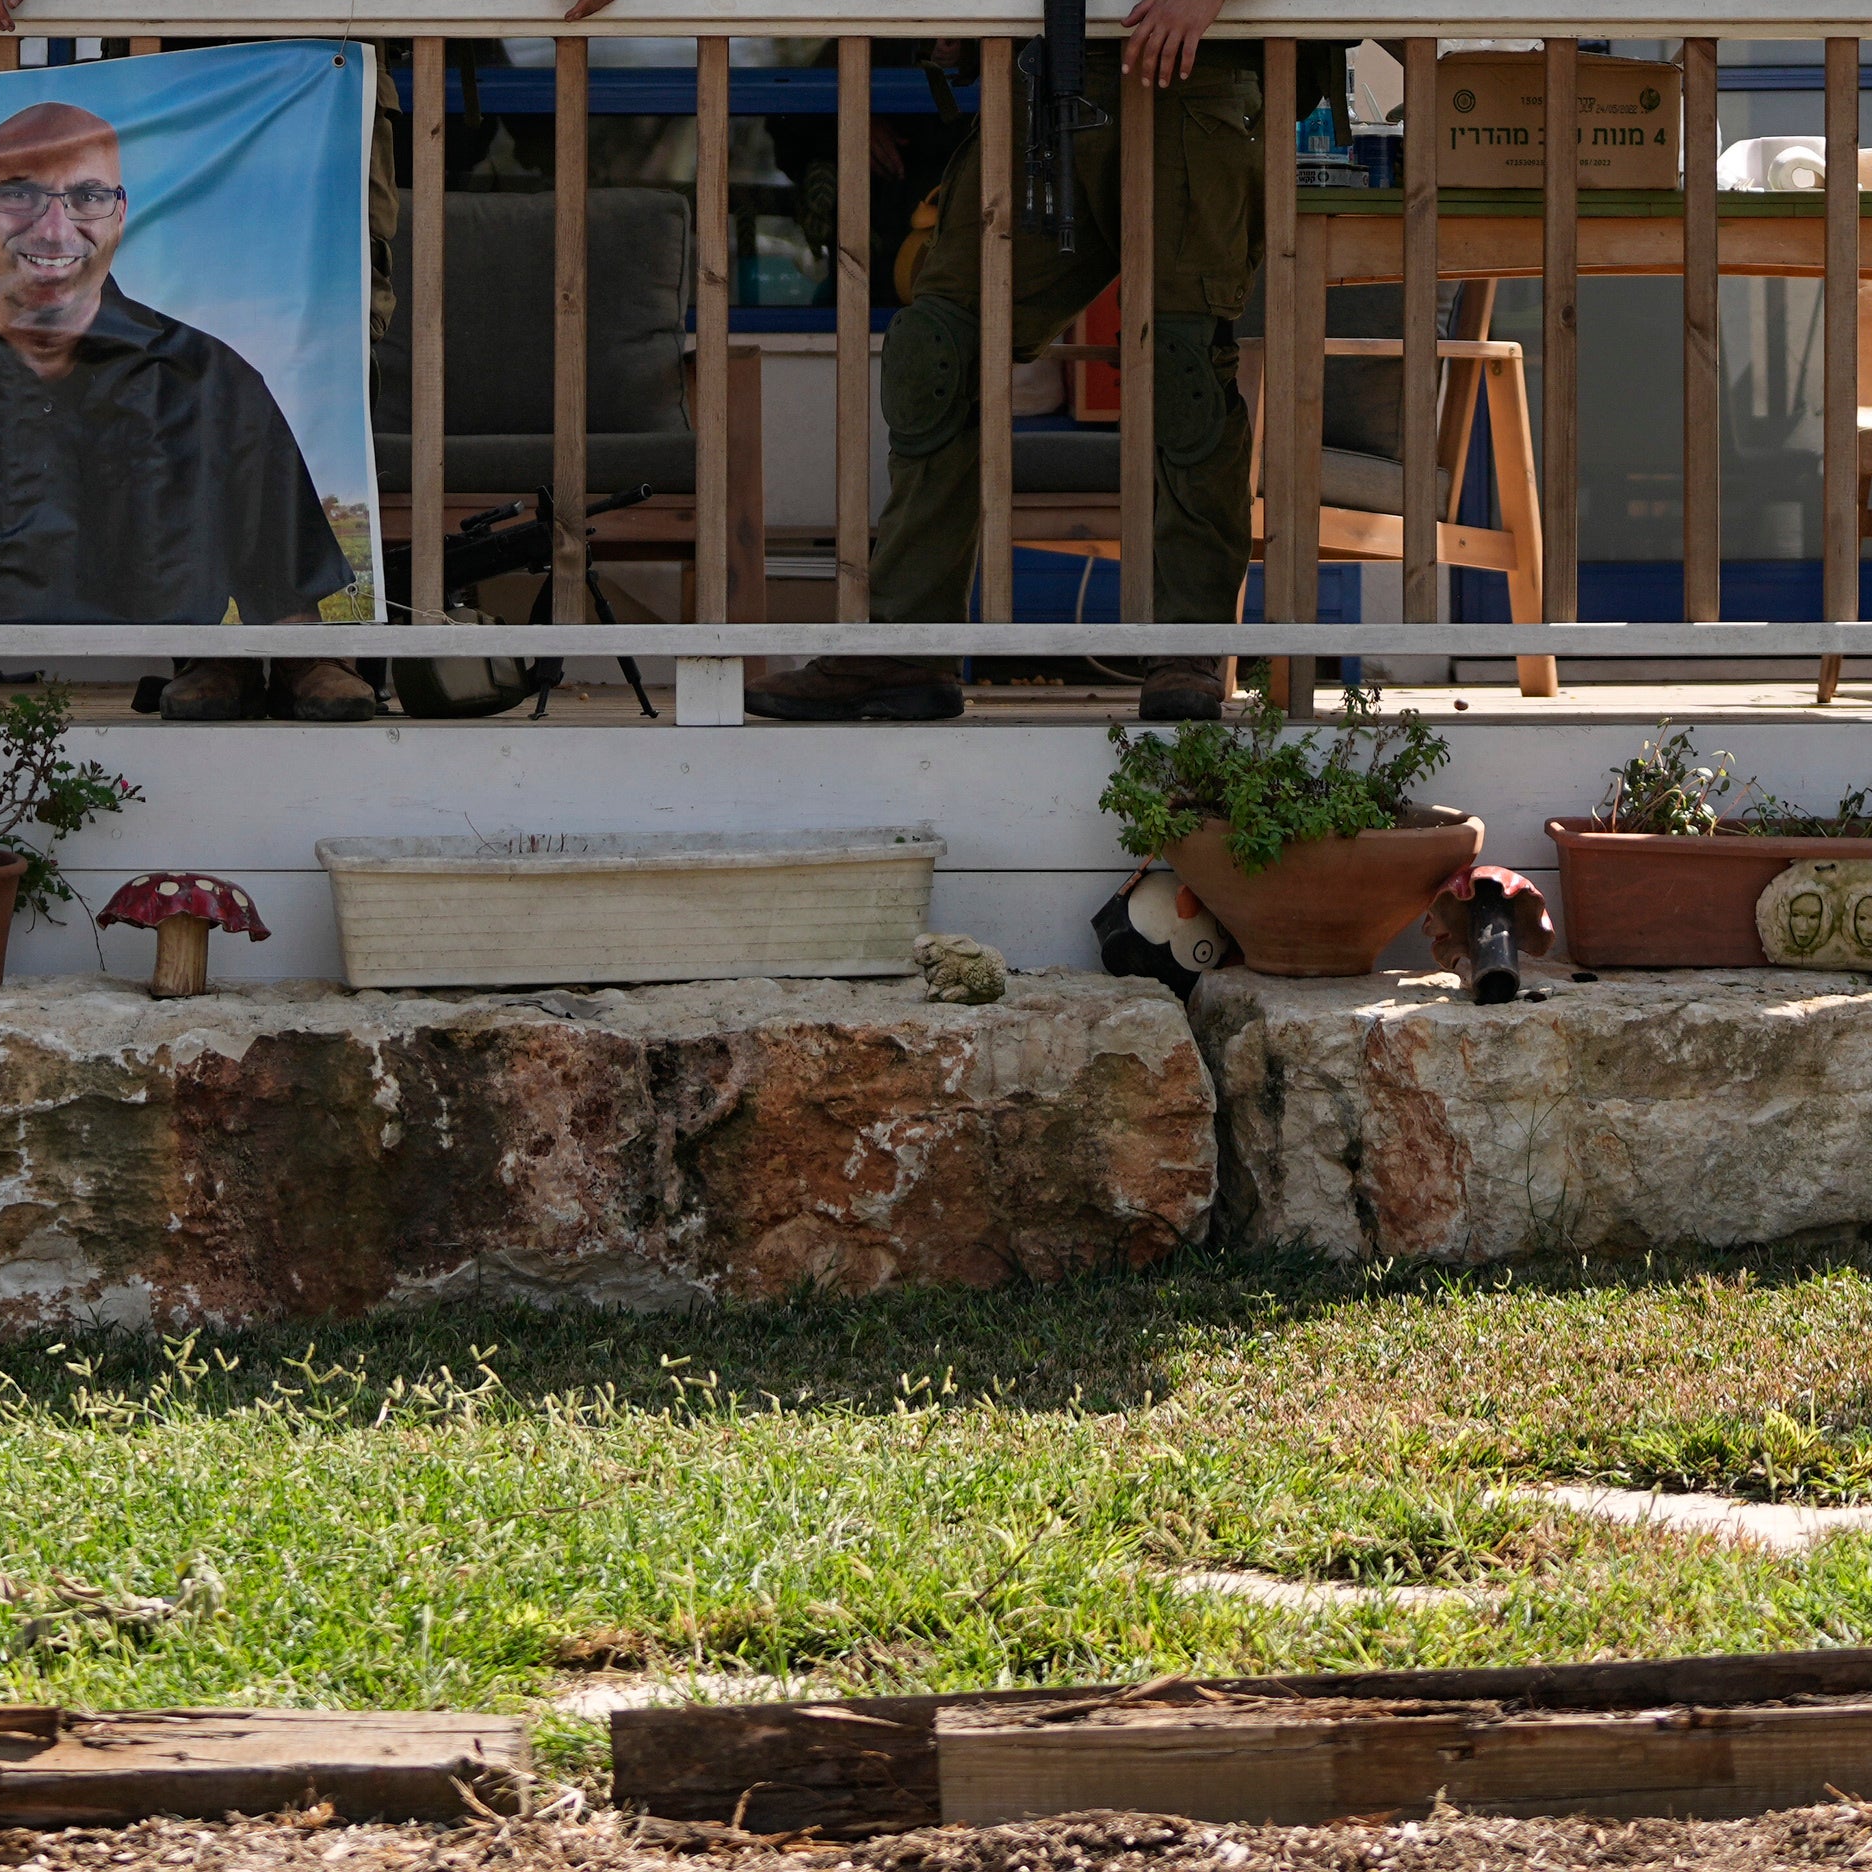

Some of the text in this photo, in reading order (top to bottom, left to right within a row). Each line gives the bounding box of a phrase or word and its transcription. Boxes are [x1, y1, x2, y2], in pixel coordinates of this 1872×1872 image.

[1450, 127, 1529, 149] מהדרין
[1592, 127, 1645, 145] מנות
[1654, 127, 1666, 145] 4
